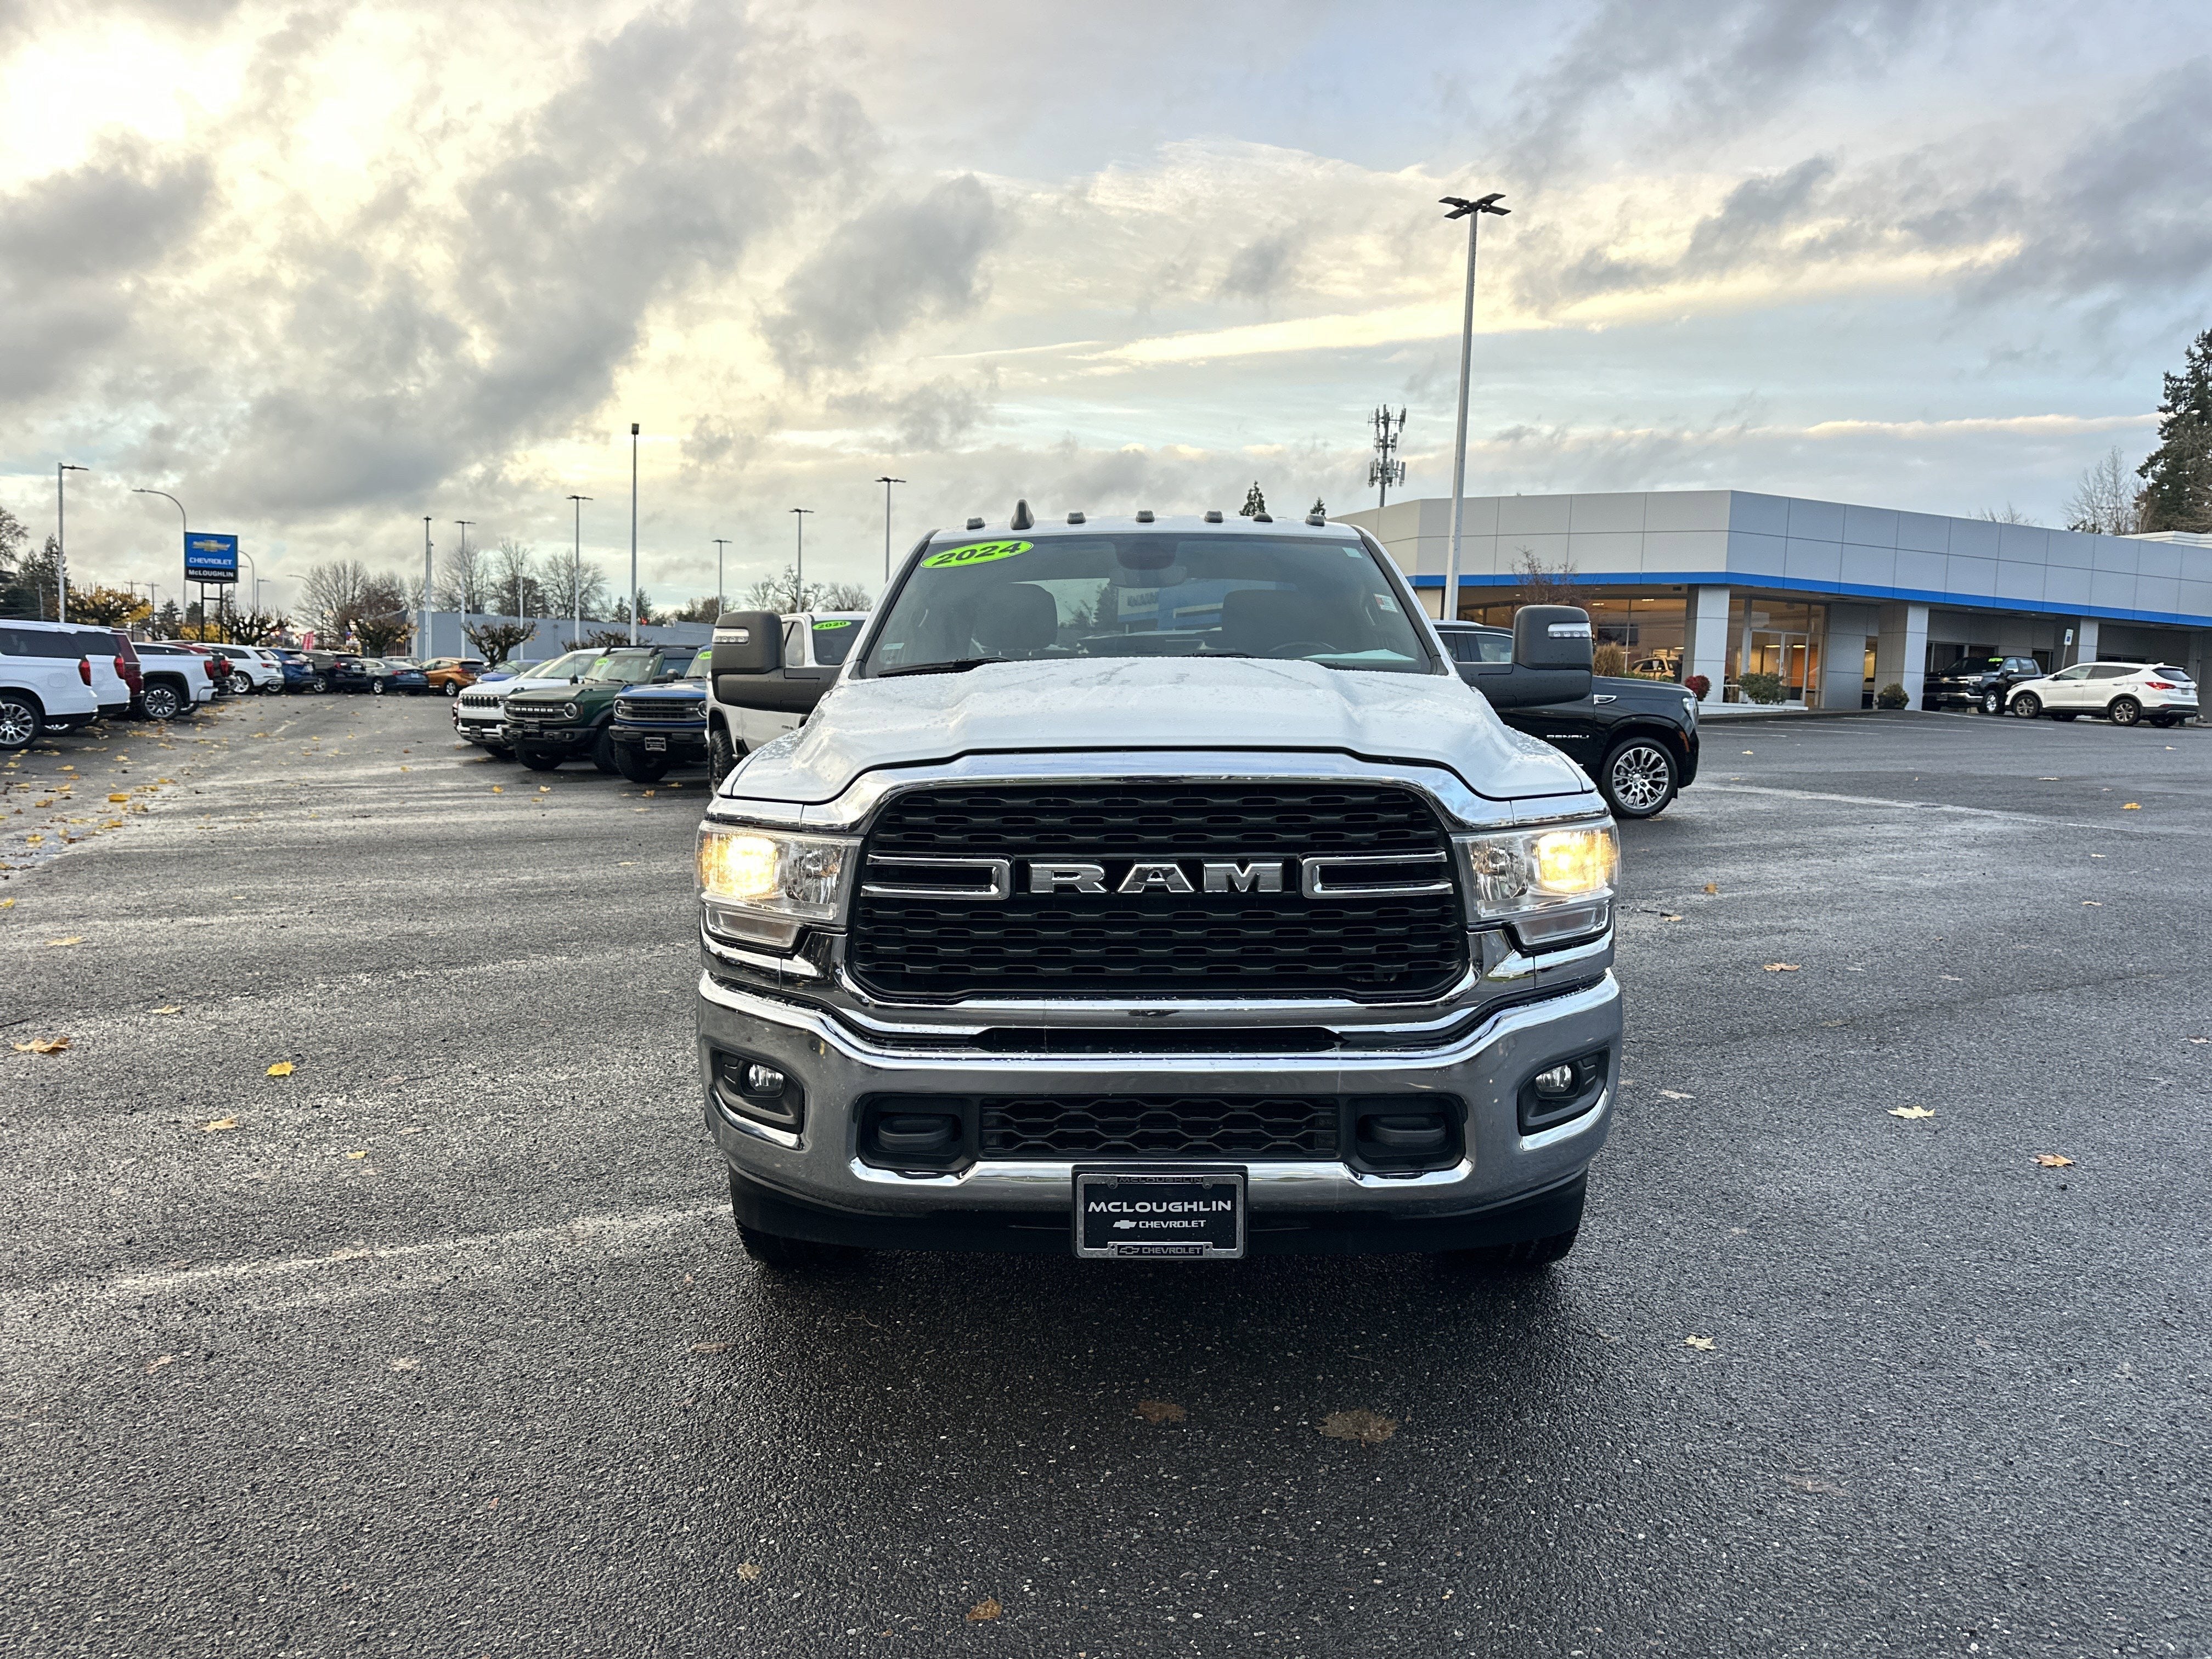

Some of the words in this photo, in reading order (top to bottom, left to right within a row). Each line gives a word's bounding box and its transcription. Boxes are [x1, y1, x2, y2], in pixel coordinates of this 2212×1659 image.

[932, 542, 1022, 566] 2024
[1030, 863, 1283, 893] RAM
[1088, 1200, 1231, 1212] MCLOUGHLIN
[1139, 1220, 1206, 1228] CHEVROLET
